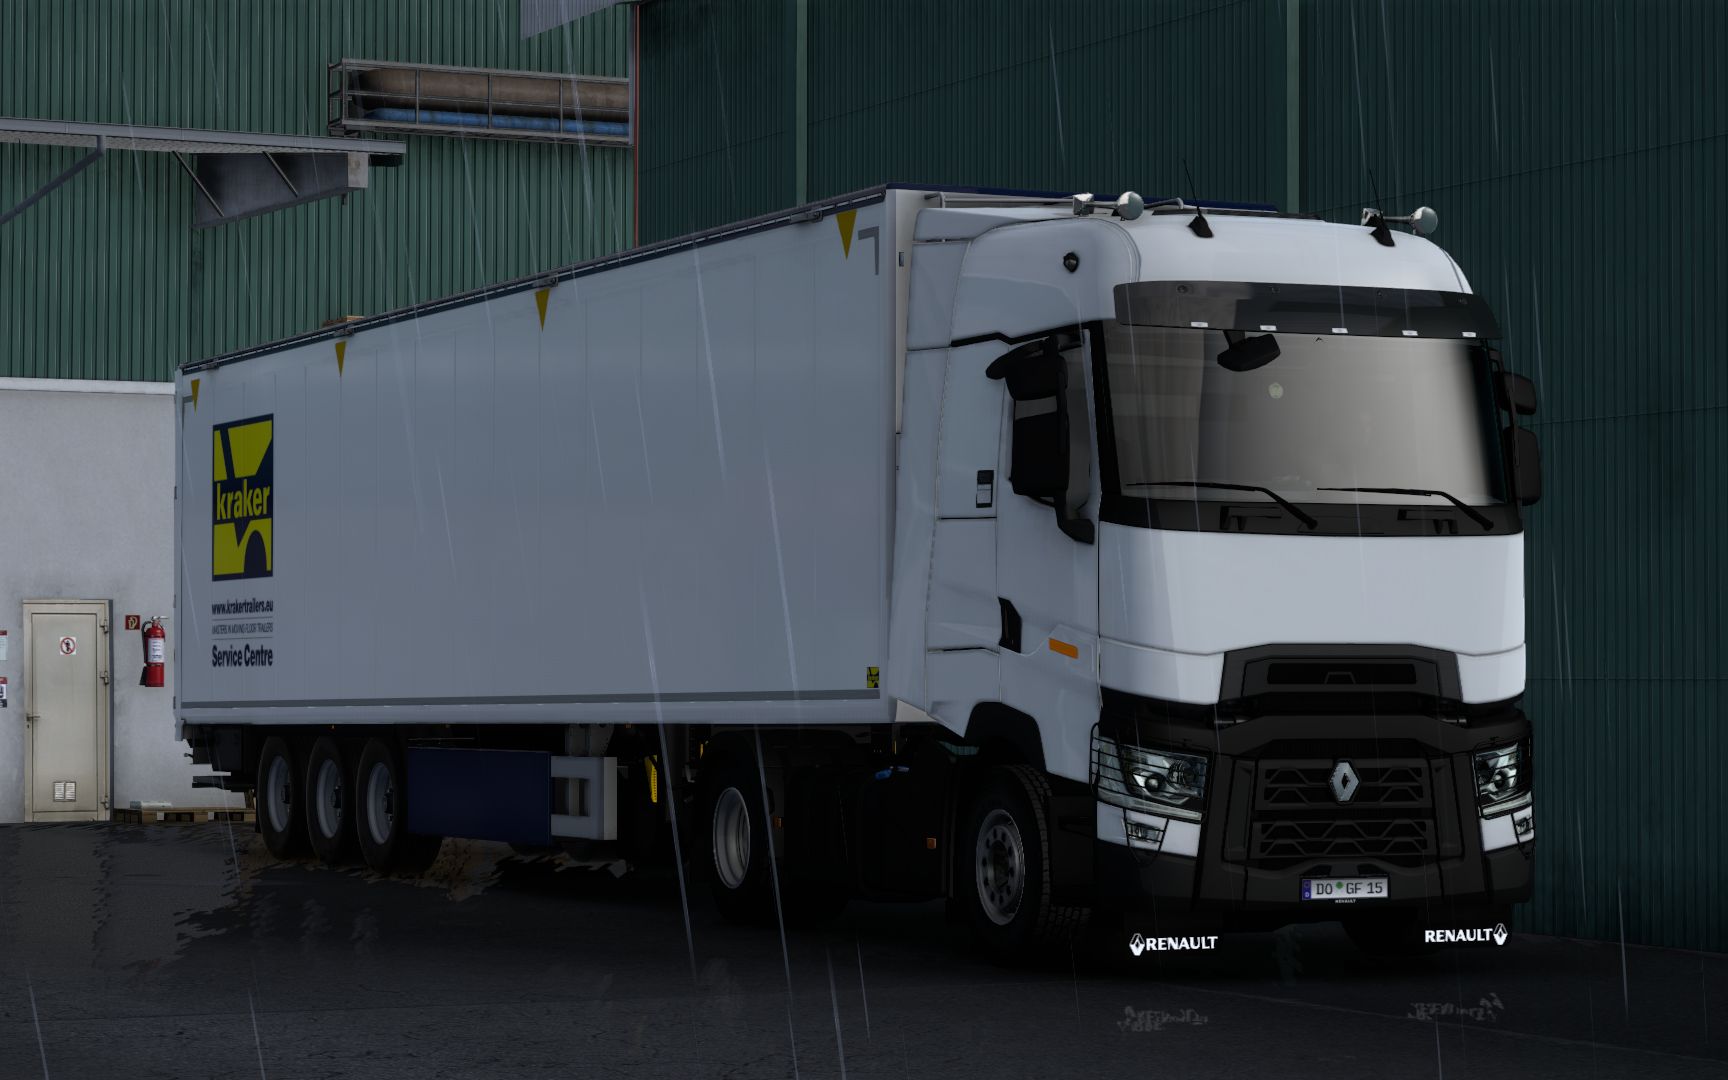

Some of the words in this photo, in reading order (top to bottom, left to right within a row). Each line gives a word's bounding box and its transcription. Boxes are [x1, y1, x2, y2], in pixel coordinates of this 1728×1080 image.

[216, 478, 271, 520] kraker
[212, 644, 243, 667] Service
[244, 643, 273, 667] Centre
[1316, 883, 1333, 895] DO
[1346, 882, 1363, 894] GF
[1367, 882, 1383, 894] 15
[1424, 928, 1493, 943] RENAULT
[1145, 936, 1219, 951] RENAULT
